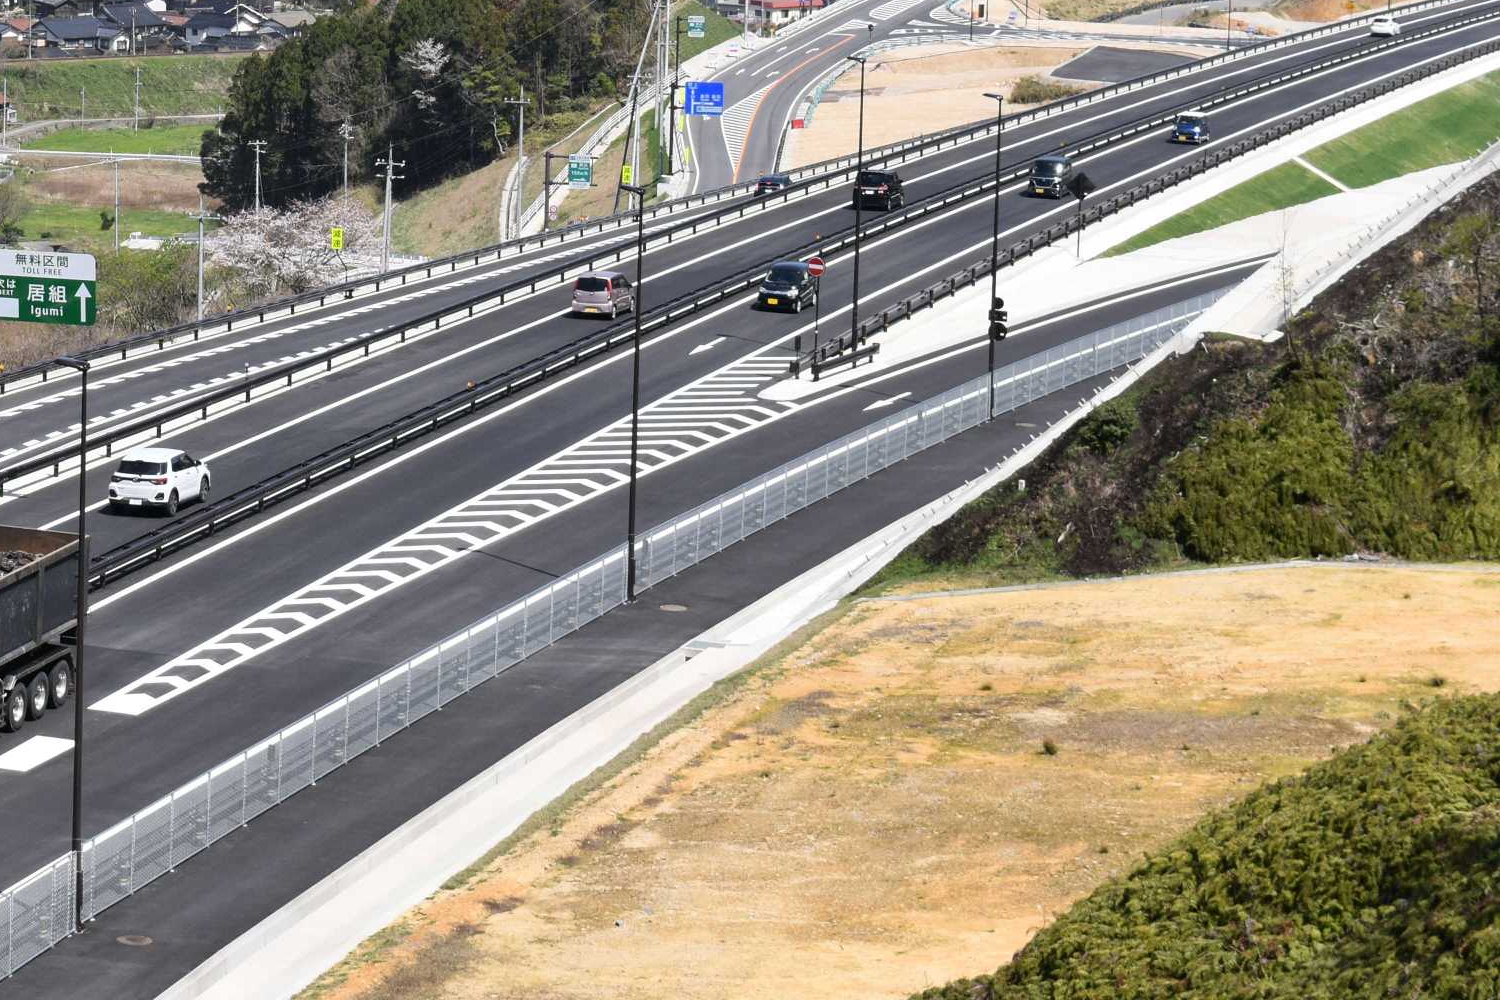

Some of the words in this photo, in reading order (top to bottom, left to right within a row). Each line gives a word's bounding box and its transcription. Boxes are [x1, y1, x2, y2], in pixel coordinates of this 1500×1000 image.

[15, 253, 69, 267] 無料区間
[22, 266, 40, 275] TOLL
[43, 268, 62, 276] FREE
[27, 283, 68, 303] 居組
[30, 305, 64, 318] Igumi
